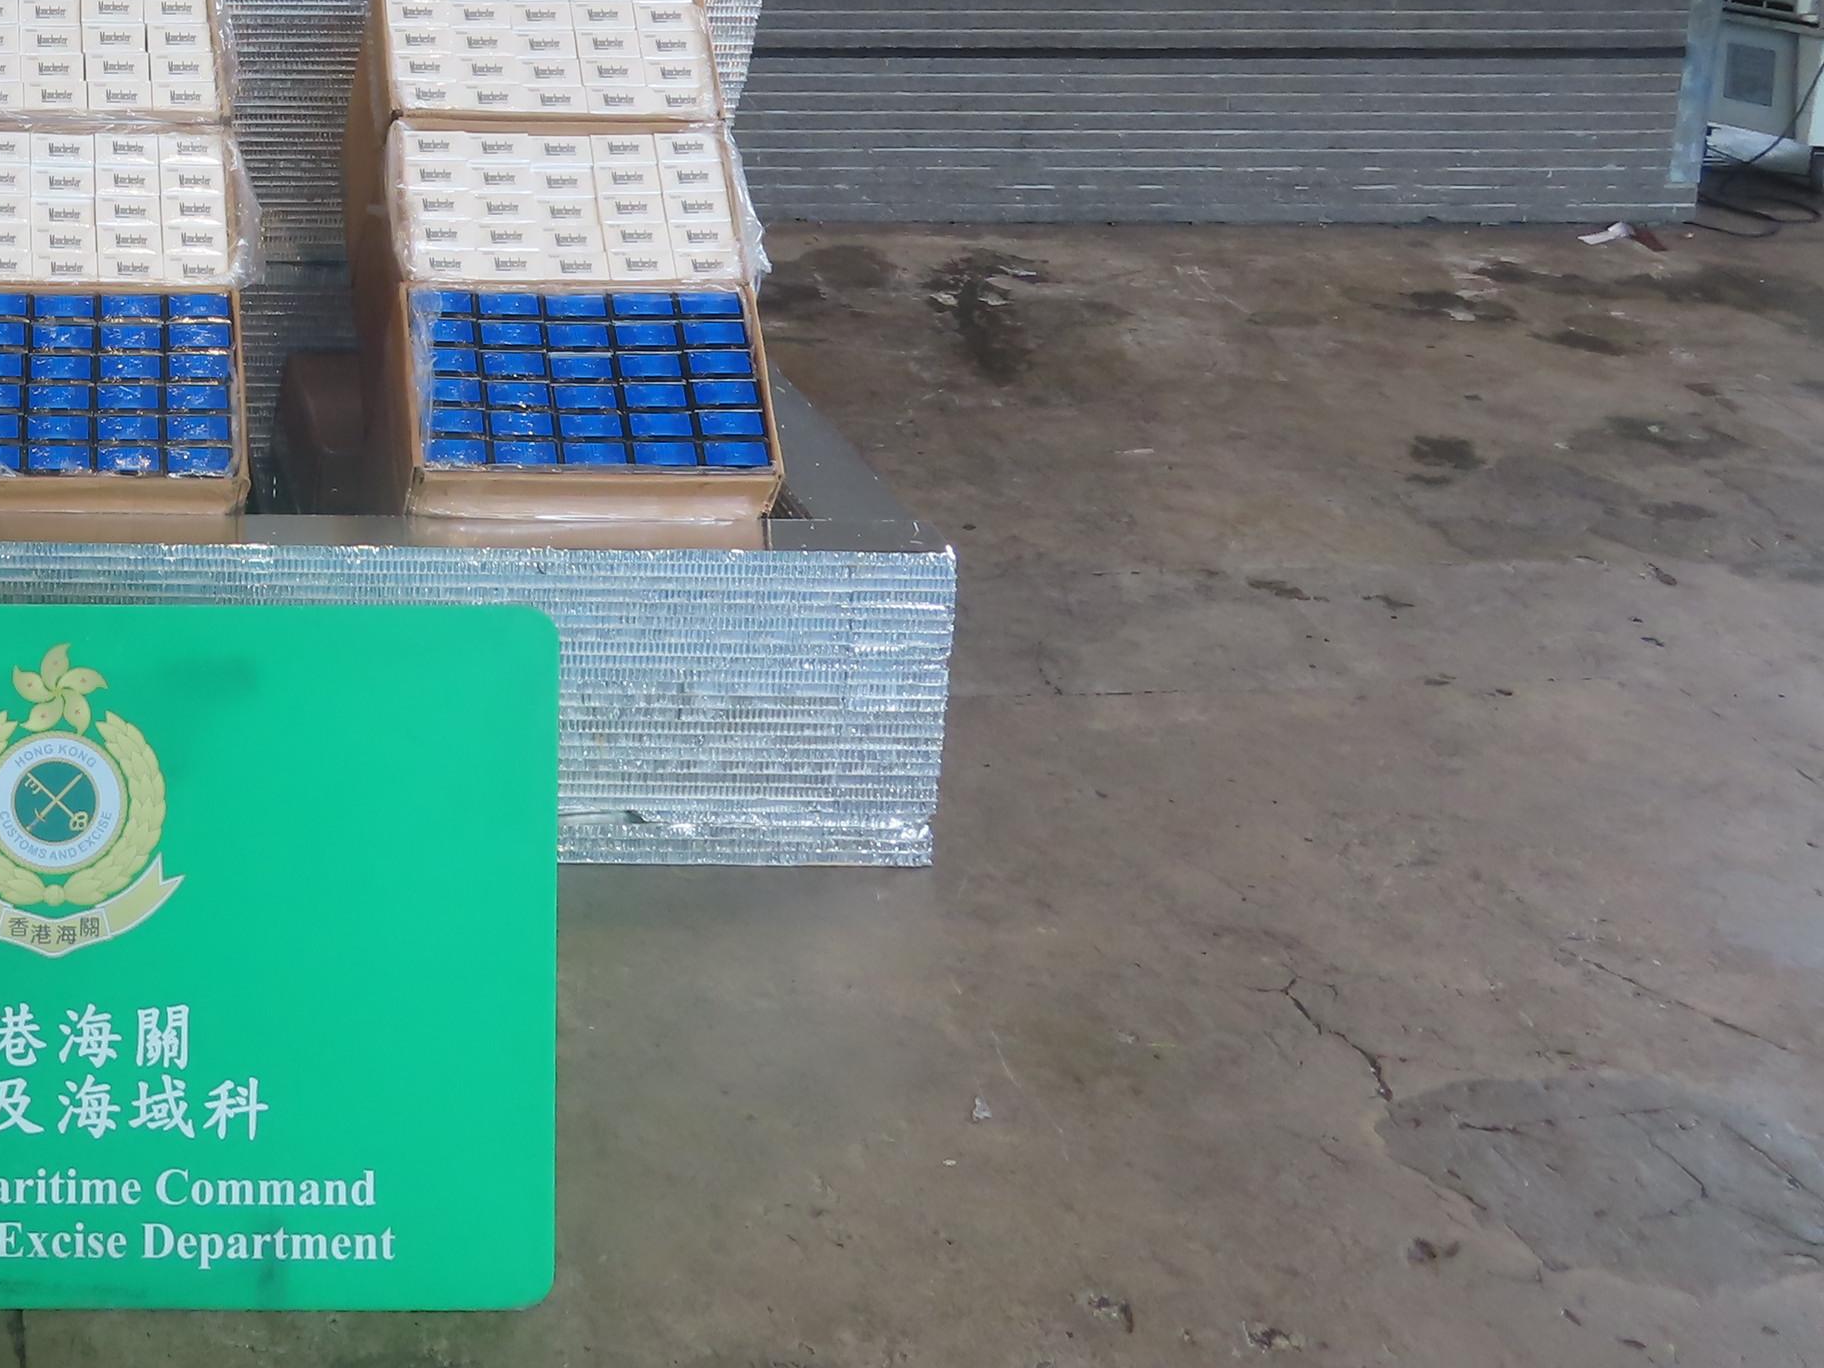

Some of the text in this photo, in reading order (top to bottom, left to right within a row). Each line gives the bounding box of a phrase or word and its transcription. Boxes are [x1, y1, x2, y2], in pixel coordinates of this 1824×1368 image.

[14, 743, 97, 769] HONG KONG
[0, 810, 112, 861] CUSTOMS AND EXCISE
[8, 917, 100, 945] 香港海關
[155, 1168, 377, 1208] Command
[142, 1221, 396, 1270] Department
